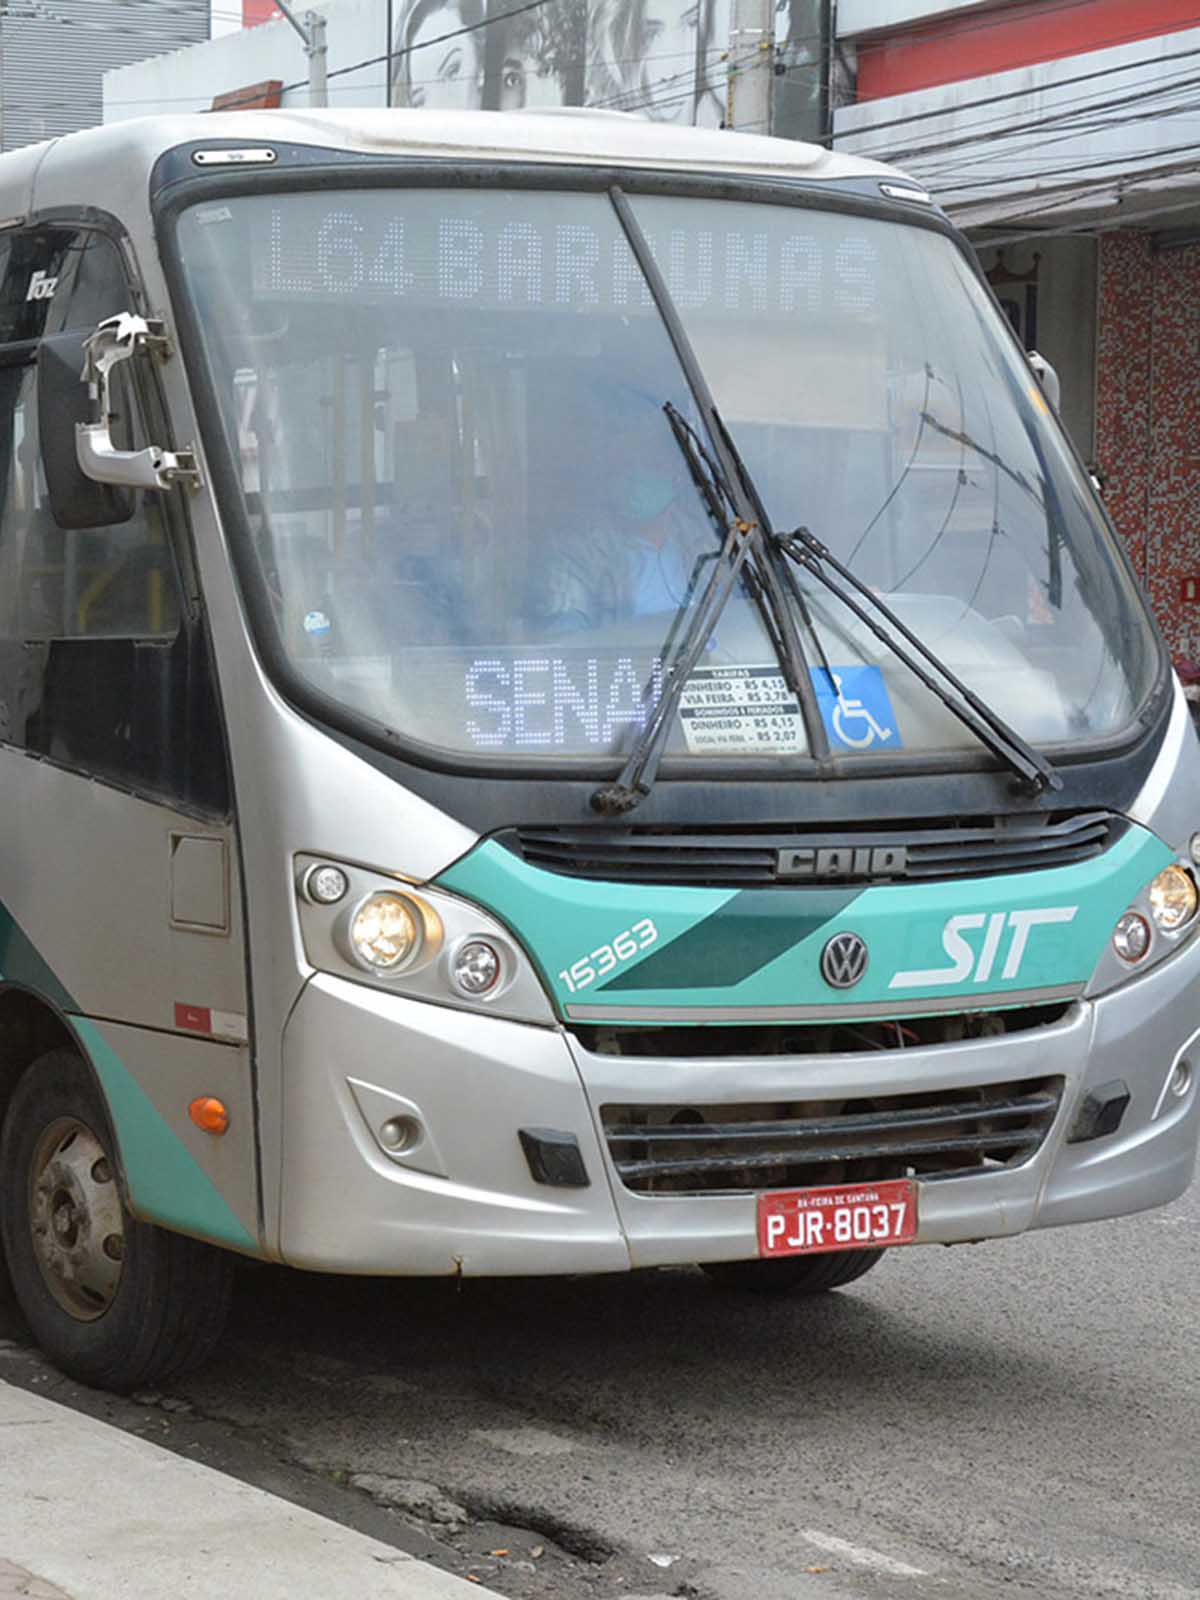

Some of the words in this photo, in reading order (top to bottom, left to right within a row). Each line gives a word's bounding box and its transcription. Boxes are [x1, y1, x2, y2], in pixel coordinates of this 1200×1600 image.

[271, 209, 415, 296] L64
[705, 693, 736, 704] FEIRA
[691, 719, 743, 730] DINHEIRO
[778, 846, 907, 874] CAIO
[559, 918, 658, 993] 15363
[888, 905, 1079, 989] SIT
